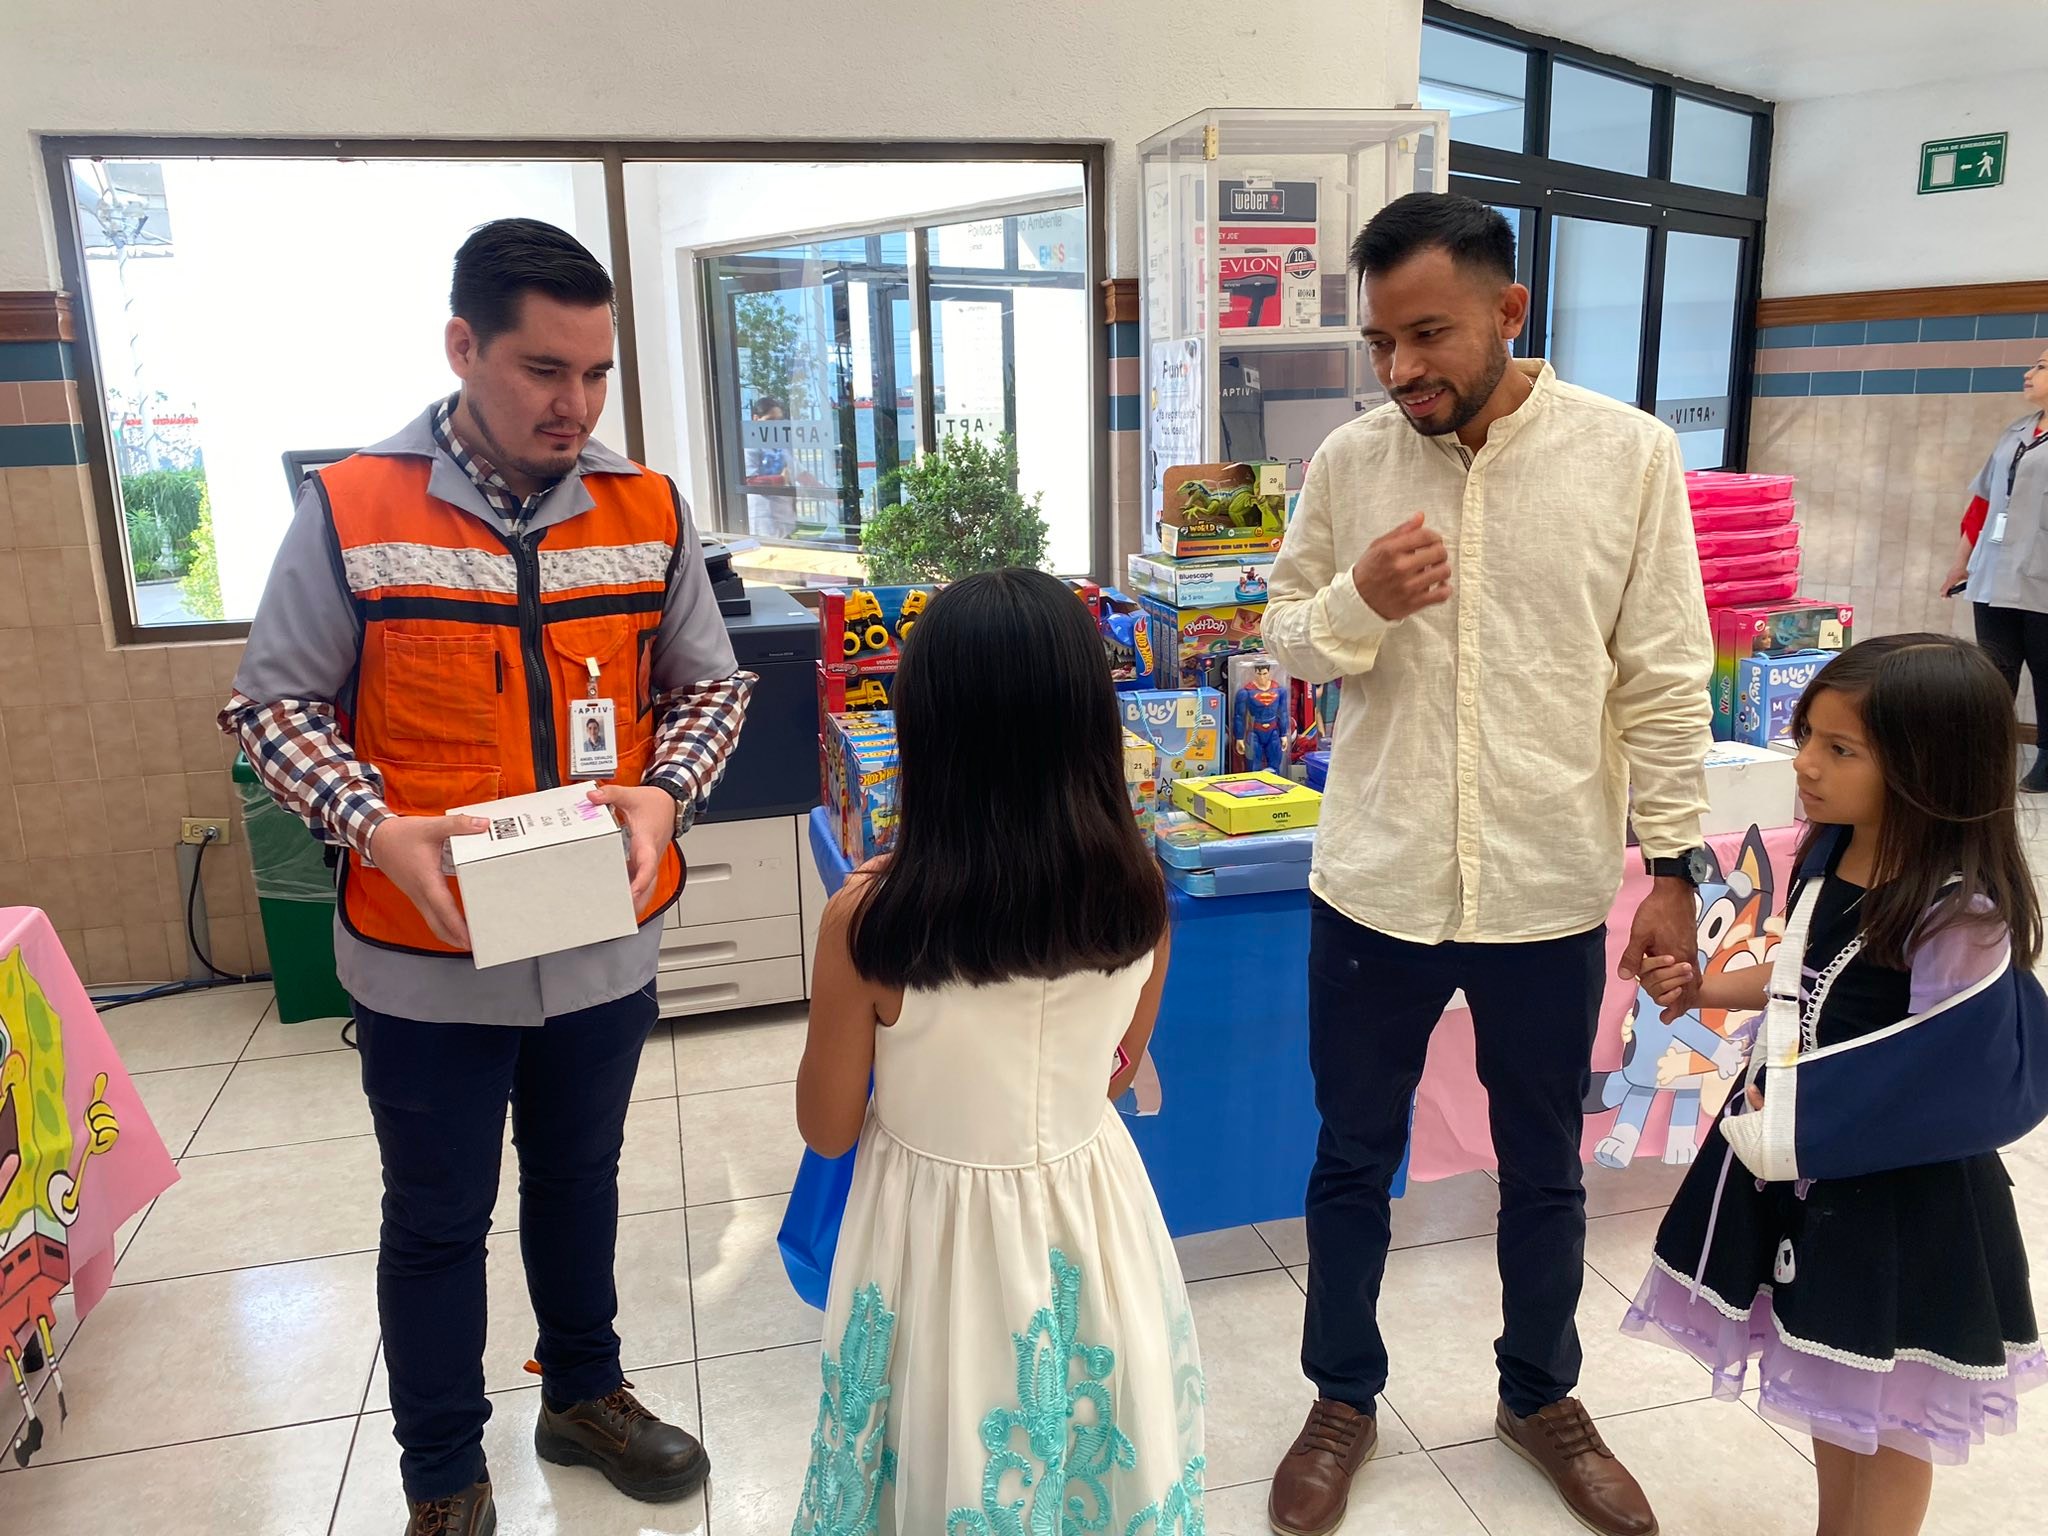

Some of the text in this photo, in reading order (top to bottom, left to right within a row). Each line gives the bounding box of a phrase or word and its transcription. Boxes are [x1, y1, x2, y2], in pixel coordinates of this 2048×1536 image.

[1960, 140, 2002, 149] EMERGENCIA
[1234, 189, 1269, 210] weber
[1027, 214, 1063, 231] Ambiente
[1294, 251, 1304, 262] 10
[1219, 257, 1280, 273] EVLON
[1222, 387, 1250, 397] APTIV
[1189, 524, 1216, 533] WORLD
[1179, 572, 1213, 580] Bluescape
[1185, 618, 1225, 635] Play-Doh
[1769, 663, 1816, 689] BLUEY
[1749, 666, 1761, 705] BLUEY
[1720, 675, 1732, 715] Nicole
[578, 706, 608, 714] APTIV
[1127, 700, 1177, 725] BLUEY
[1272, 811, 1291, 819] onn.
